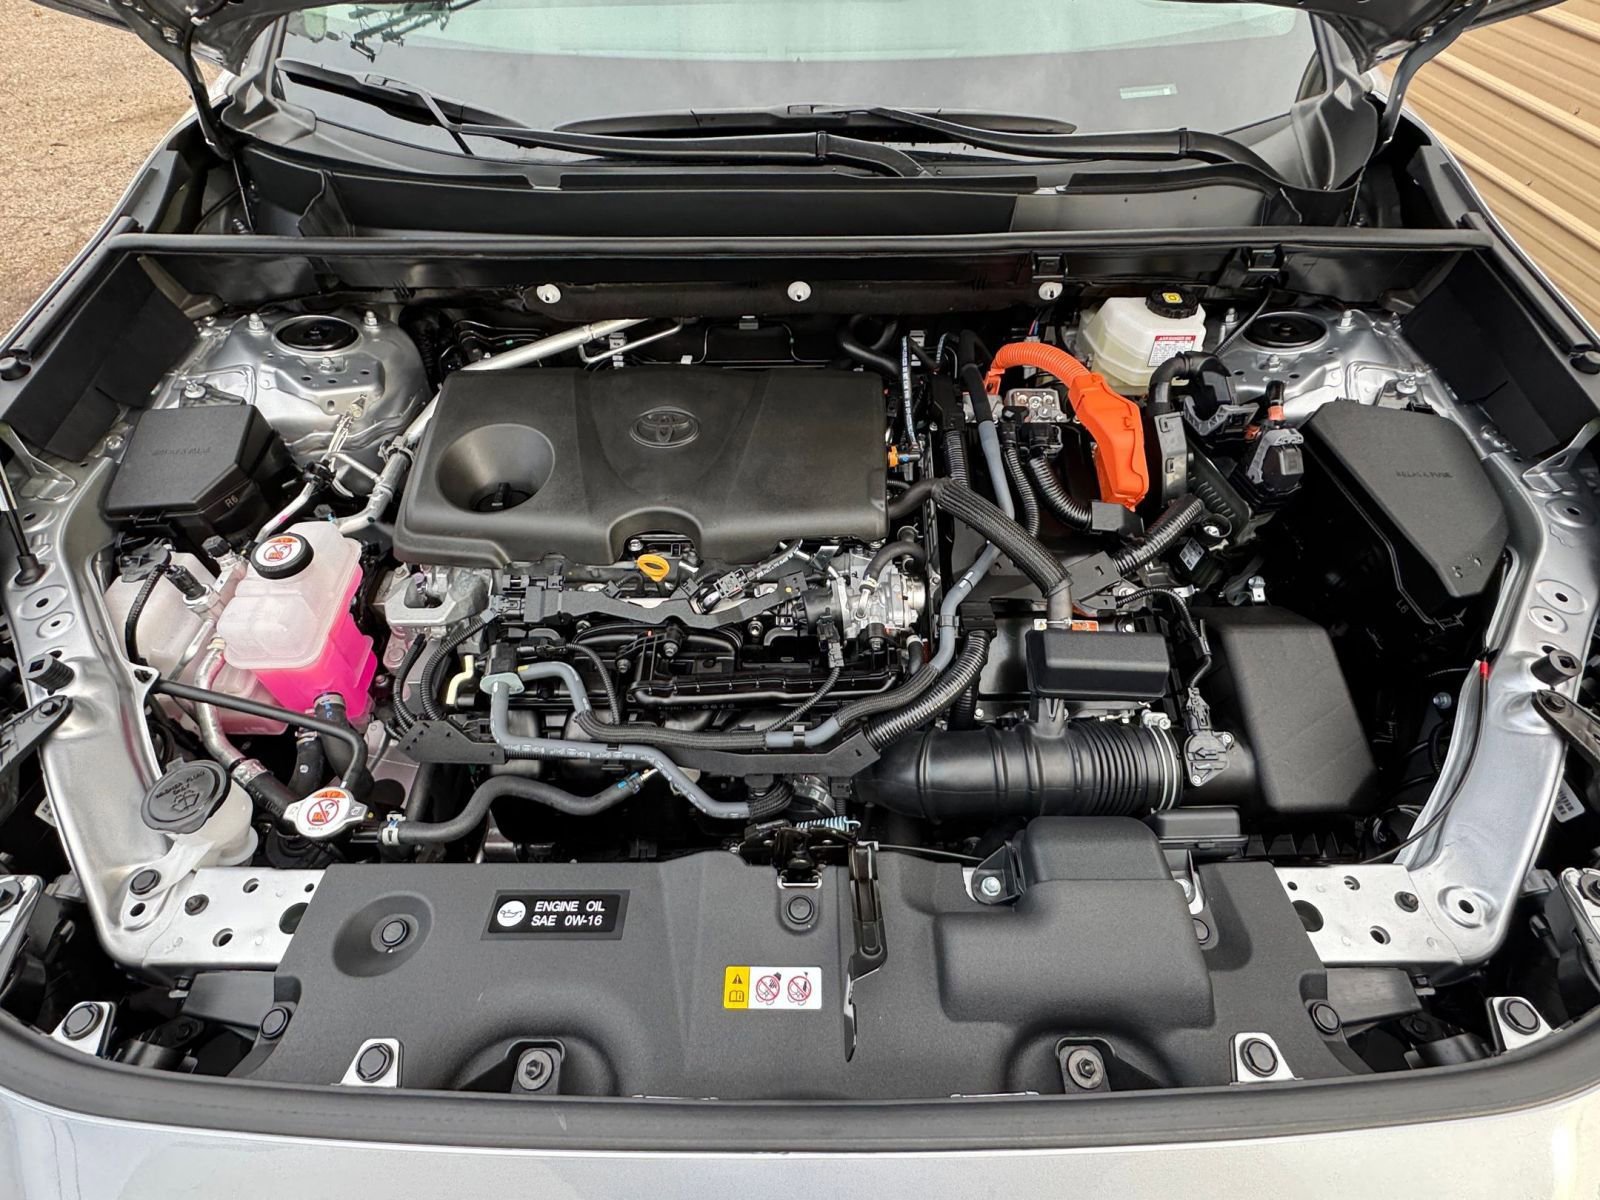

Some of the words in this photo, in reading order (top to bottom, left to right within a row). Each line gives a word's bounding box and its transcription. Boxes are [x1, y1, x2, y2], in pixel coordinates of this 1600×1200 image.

[224, 495, 239, 508] R6
[534, 900, 580, 912] ENGINE
[585, 900, 606, 912] OIL
[531, 914, 557, 927] SAE
[564, 914, 603, 927] 0W-16
